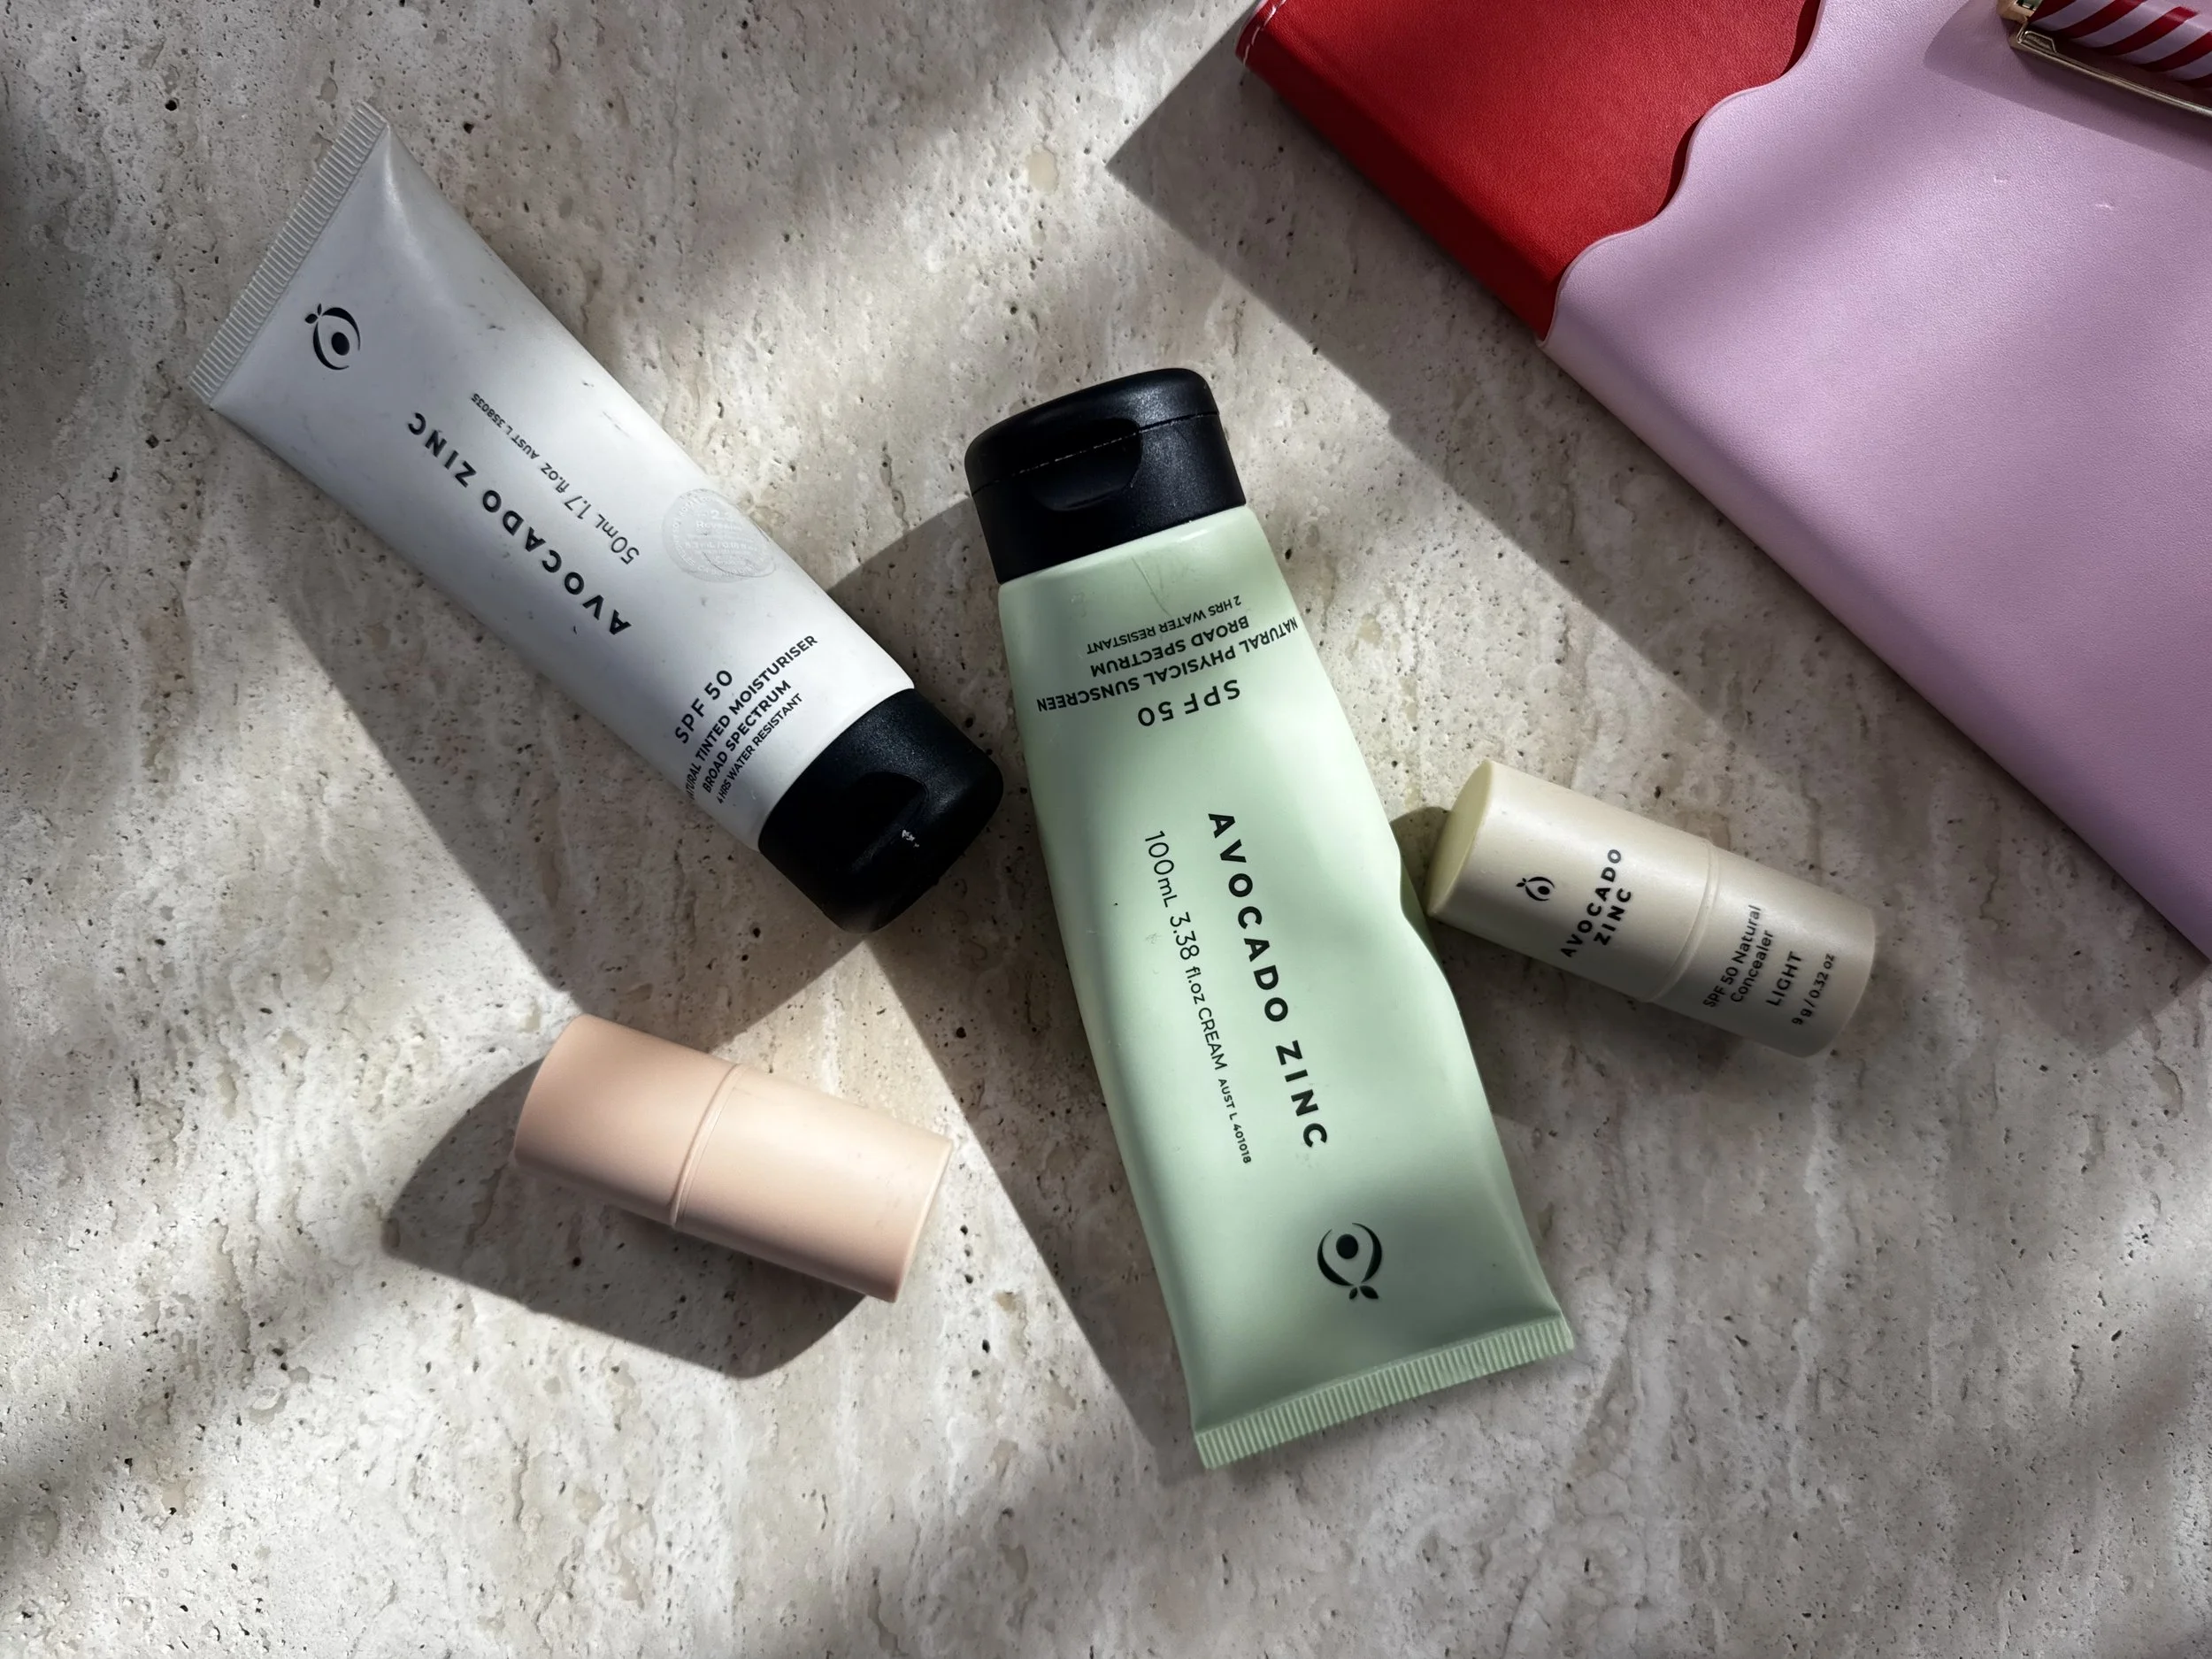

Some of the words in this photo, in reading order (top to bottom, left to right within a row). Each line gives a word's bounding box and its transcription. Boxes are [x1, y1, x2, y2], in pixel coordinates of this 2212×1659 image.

[471, 394, 505, 428] 358035
[506, 426, 513, 435] L
[511, 434, 540, 459] AUST
[408, 412, 477, 488] ZINC
[564, 495, 592, 519] 1.7
[595, 514, 640, 565] 50mL
[482, 489, 632, 635] AVOCADO
[1208, 598, 1233, 617] HRS
[1233, 595, 1241, 606] 2
[1159, 610, 1206, 633] WATER
[1191, 615, 1249, 647] BROAD
[1239, 617, 1299, 653] NATURAL
[1087, 626, 1156, 655] RESISTANT
[1089, 639, 1187, 677] SPECTRUM
[1143, 645, 1236, 686] PHYSICAL
[675, 697, 704, 744] SPF
[704, 670, 733, 700] 50
[695, 715, 731, 762] TINTED
[728, 635, 818, 716] MOISTURISER
[1036, 676, 1141, 712] SUNSCREEN
[1184, 679, 1240, 715] SPF
[752, 693, 803, 747] RESISTANT
[1137, 701, 1174, 727] 50
[702, 751, 727, 793] BROAD
[726, 680, 792, 752] SPECTRUM
[727, 744, 755, 781] WATER
[716, 795, 724, 804] 4
[718, 779, 732, 799] HRS
[1145, 830, 1178, 908] 100mL
[1560, 849, 1621, 957] AVOCADO
[1593, 887, 1632, 946] ZINC
[1170, 911, 1200, 960] 3.38
[1702, 986, 1726, 1008] SPF
[1720, 966, 1738, 985] 50
[1732, 904, 1761, 964] Natural
[1730, 930, 1773, 1002] Concealer
[1824, 953, 1835, 969] oz
[1208, 813, 1288, 1022] AVOCADO
[1275, 1040, 1327, 1148] ZINC
[1766, 951, 1801, 1006] LIGHT
[1198, 1007, 1227, 1071] CREAM
[1217, 1078, 1235, 1109] AUST
[1229, 1112, 1238, 1121] L
[1233, 1124, 1252, 1164] 401018
